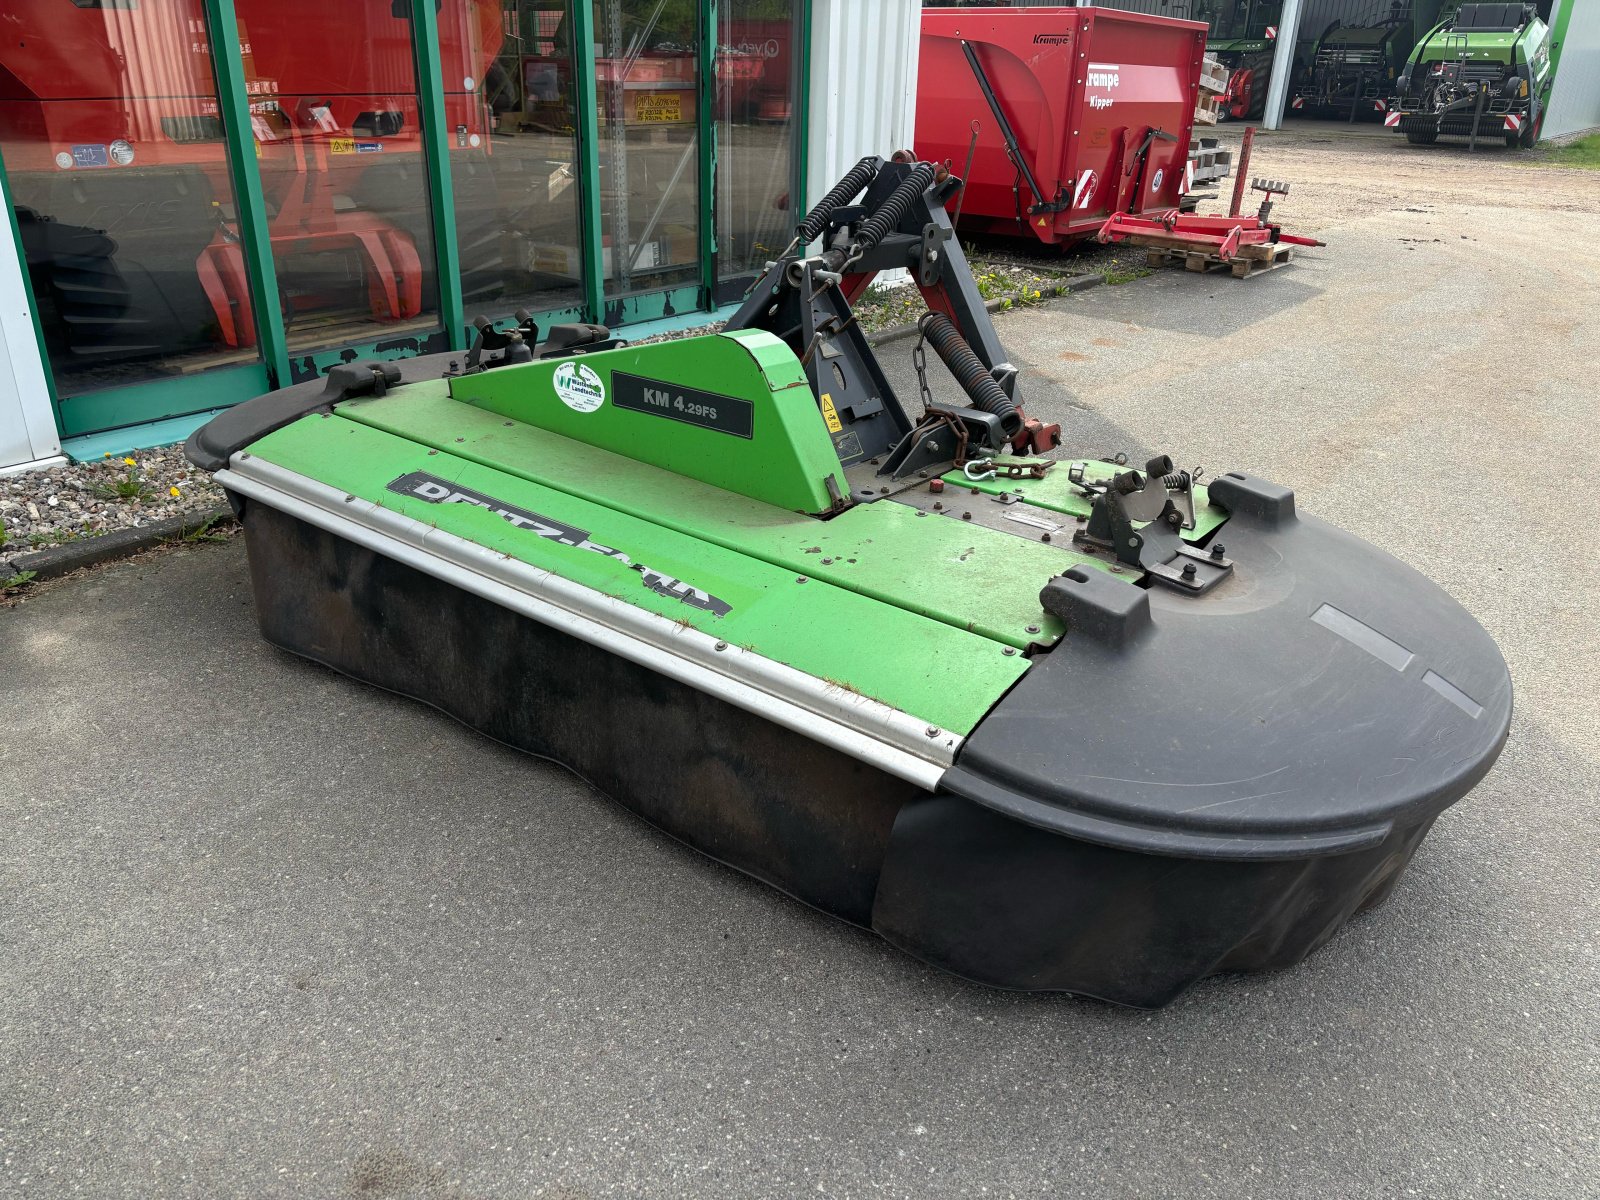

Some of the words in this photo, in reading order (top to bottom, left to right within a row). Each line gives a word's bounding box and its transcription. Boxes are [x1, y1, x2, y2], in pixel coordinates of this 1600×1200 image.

[1033, 34, 1069, 46] Krampe
[1086, 65, 1119, 92] rampe
[1089, 96, 1114, 110] Kipper
[572, 385, 602, 398] Landtechnik
[643, 387, 670, 408] KM
[673, 395, 718, 420] 4.29FS
